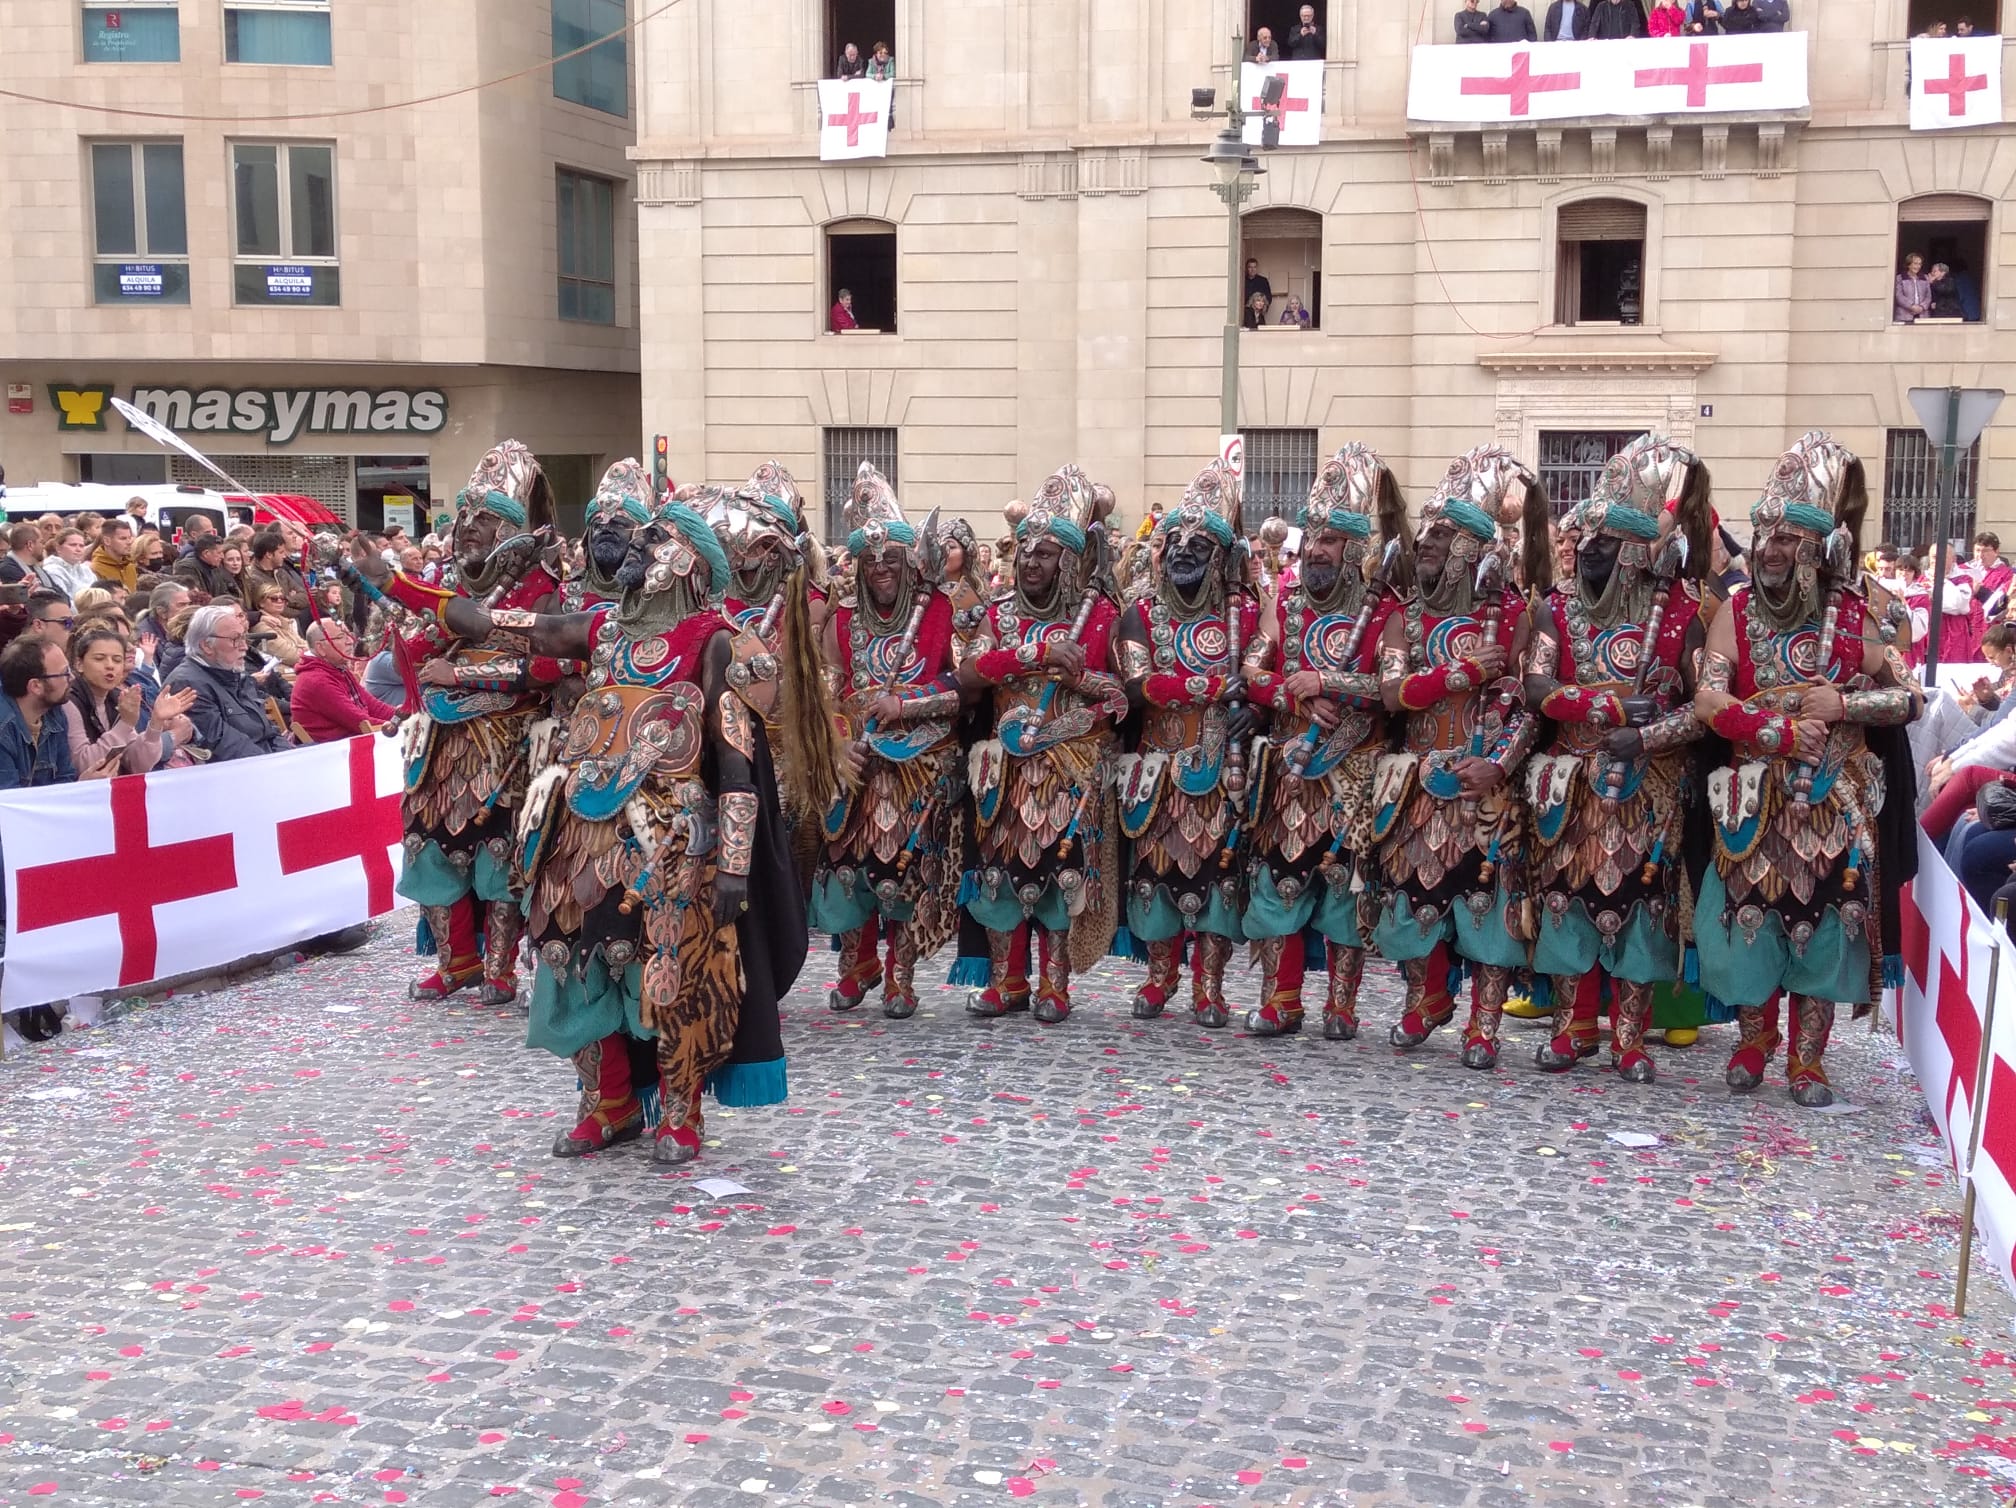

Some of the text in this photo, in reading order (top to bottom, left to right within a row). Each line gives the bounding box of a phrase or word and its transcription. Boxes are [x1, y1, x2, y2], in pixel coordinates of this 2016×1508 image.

[126, 276, 156, 284] ALQUILA
[131, 389, 444, 442] masymas
[1703, 405, 1710, 416] 4
